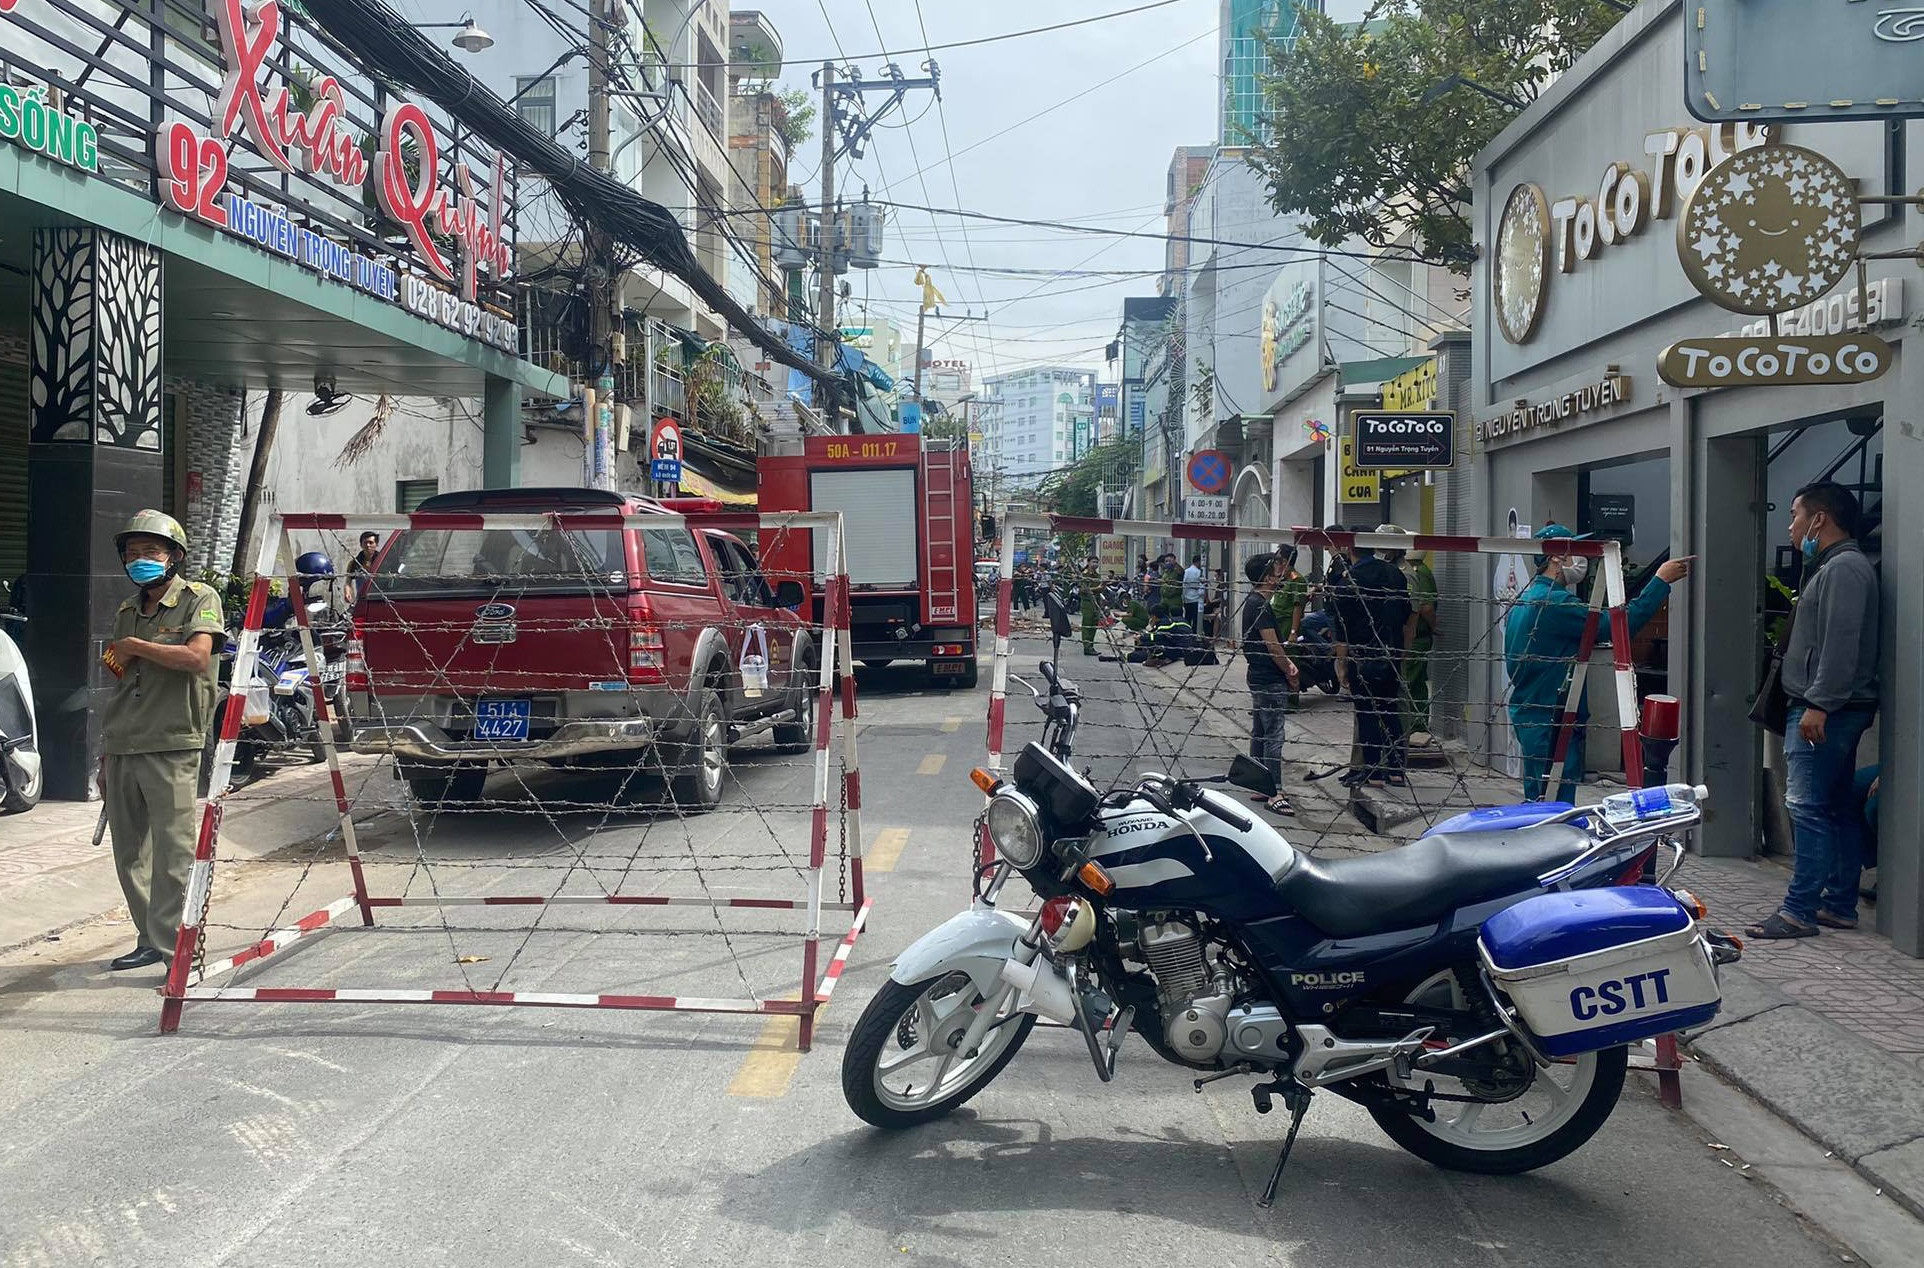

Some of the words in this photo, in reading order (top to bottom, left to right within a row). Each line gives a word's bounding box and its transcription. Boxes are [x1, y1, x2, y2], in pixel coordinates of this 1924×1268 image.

[222, 0, 368, 186] Xuân
[0, 84, 98, 173] SỐNG
[169, 123, 229, 228] 92
[231, 203, 299, 259] NGUYỄN
[303, 230, 351, 279] TRỌNG
[407, 274, 438, 319] 028
[442, 291, 460, 328] 62
[463, 304, 481, 337] 92
[485, 311, 501, 345] 92
[504, 320, 519, 355] 93
[1677, 343, 1879, 379] ToCoToCo
[1365, 419, 1445, 434] ToCoToCo
[827, 444, 850, 458] 50A
[861, 442, 897, 457] 011.17
[1348, 486, 1371, 497] CUA
[1103, 540, 1124, 550] GAME
[486, 702, 518, 718] 51A
[480, 719, 523, 736] 4427
[1107, 821, 1170, 838] HONDA
[1290, 971, 1365, 985] POLICE
[1570, 968, 1670, 1020] CSTT
